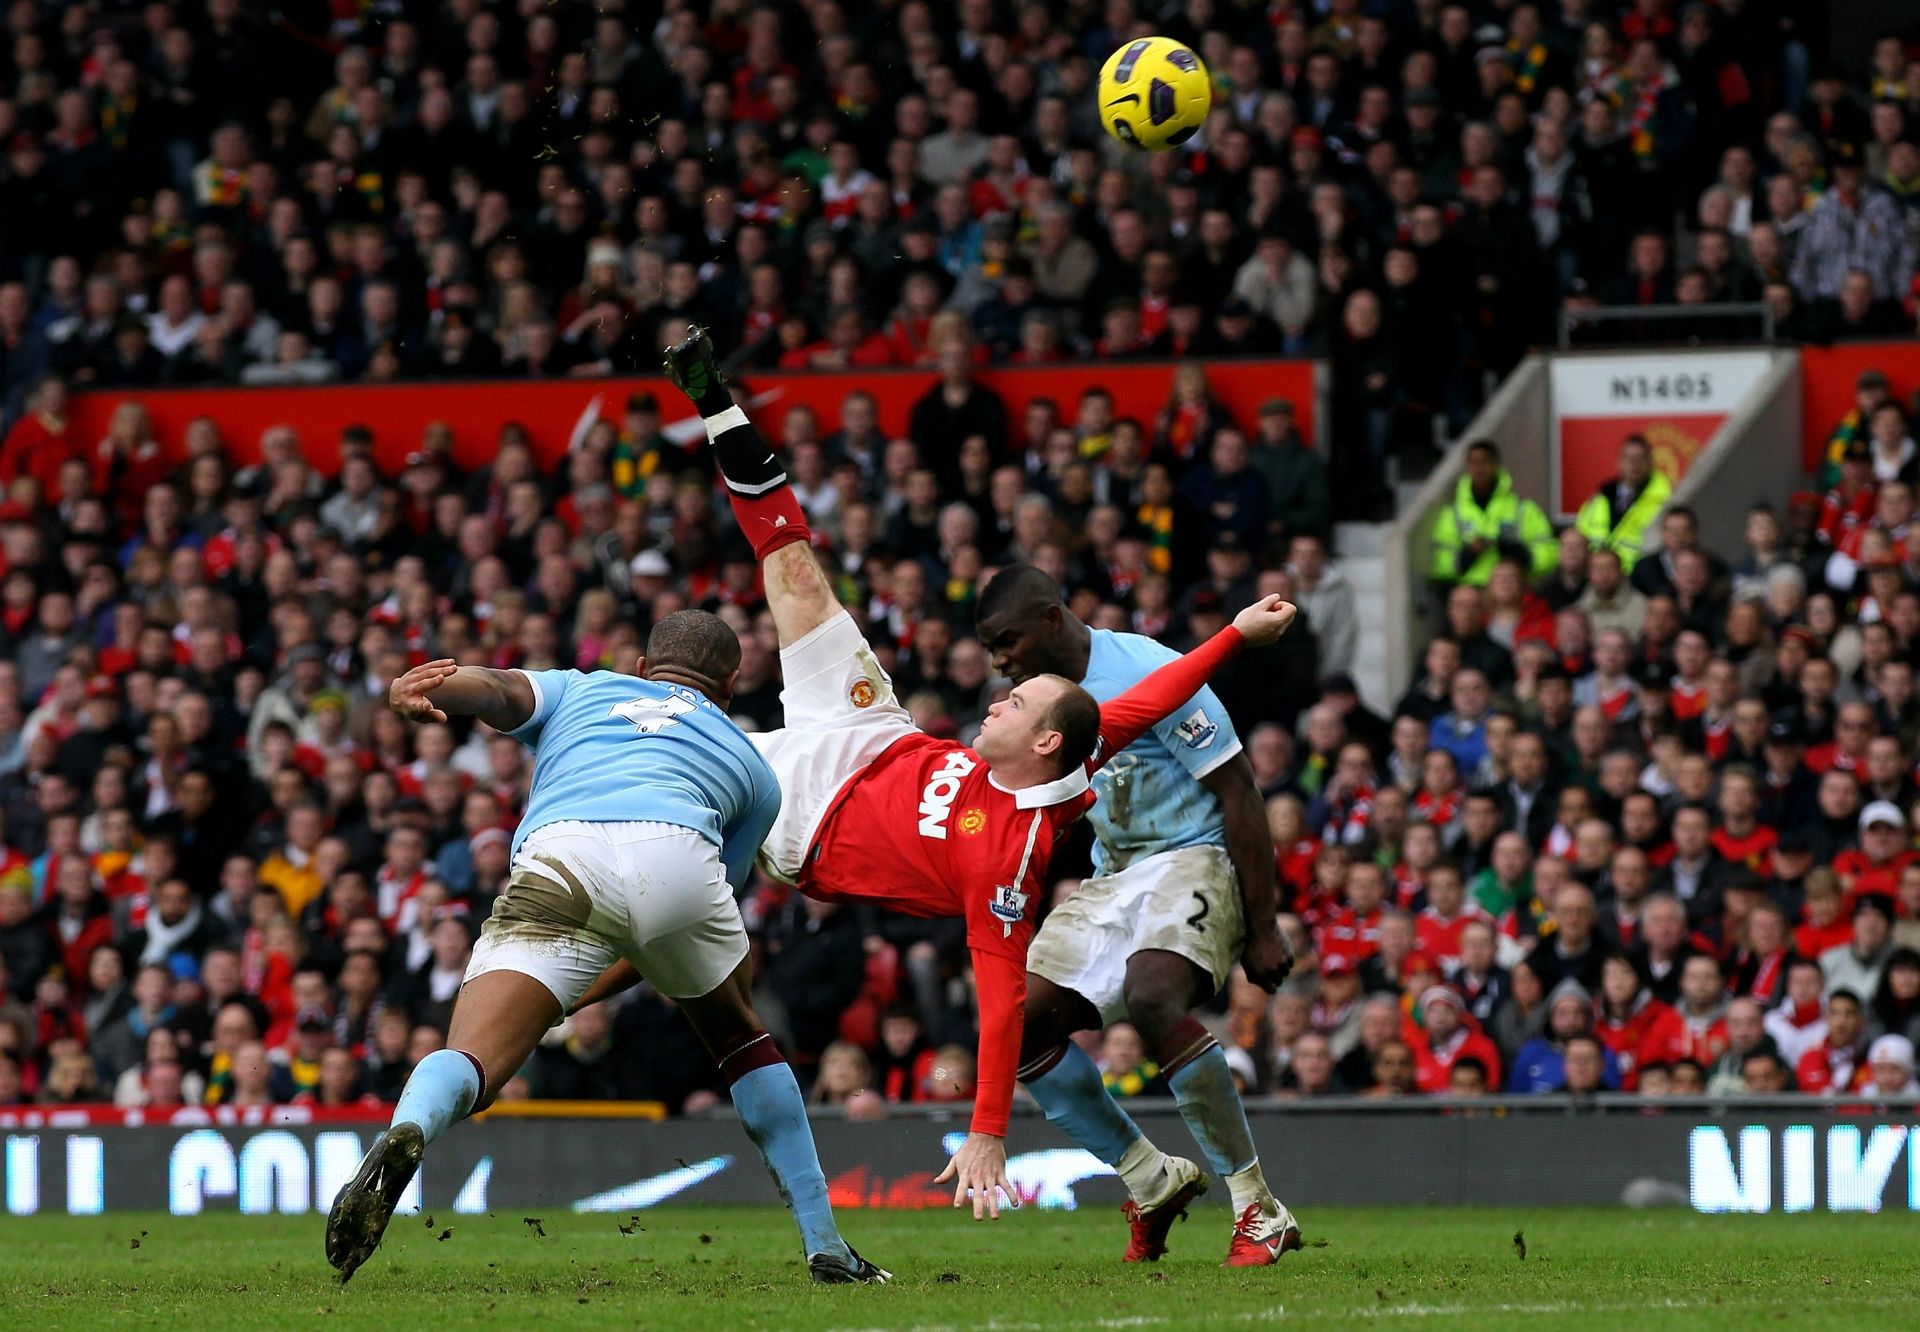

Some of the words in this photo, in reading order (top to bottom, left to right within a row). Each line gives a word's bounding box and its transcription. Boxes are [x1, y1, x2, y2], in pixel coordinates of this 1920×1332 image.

[1611, 372, 1713, 399] N1405
[918, 751, 977, 840] AON
[1186, 890, 1209, 933] 2
[1689, 1124, 1920, 1213] NIK
